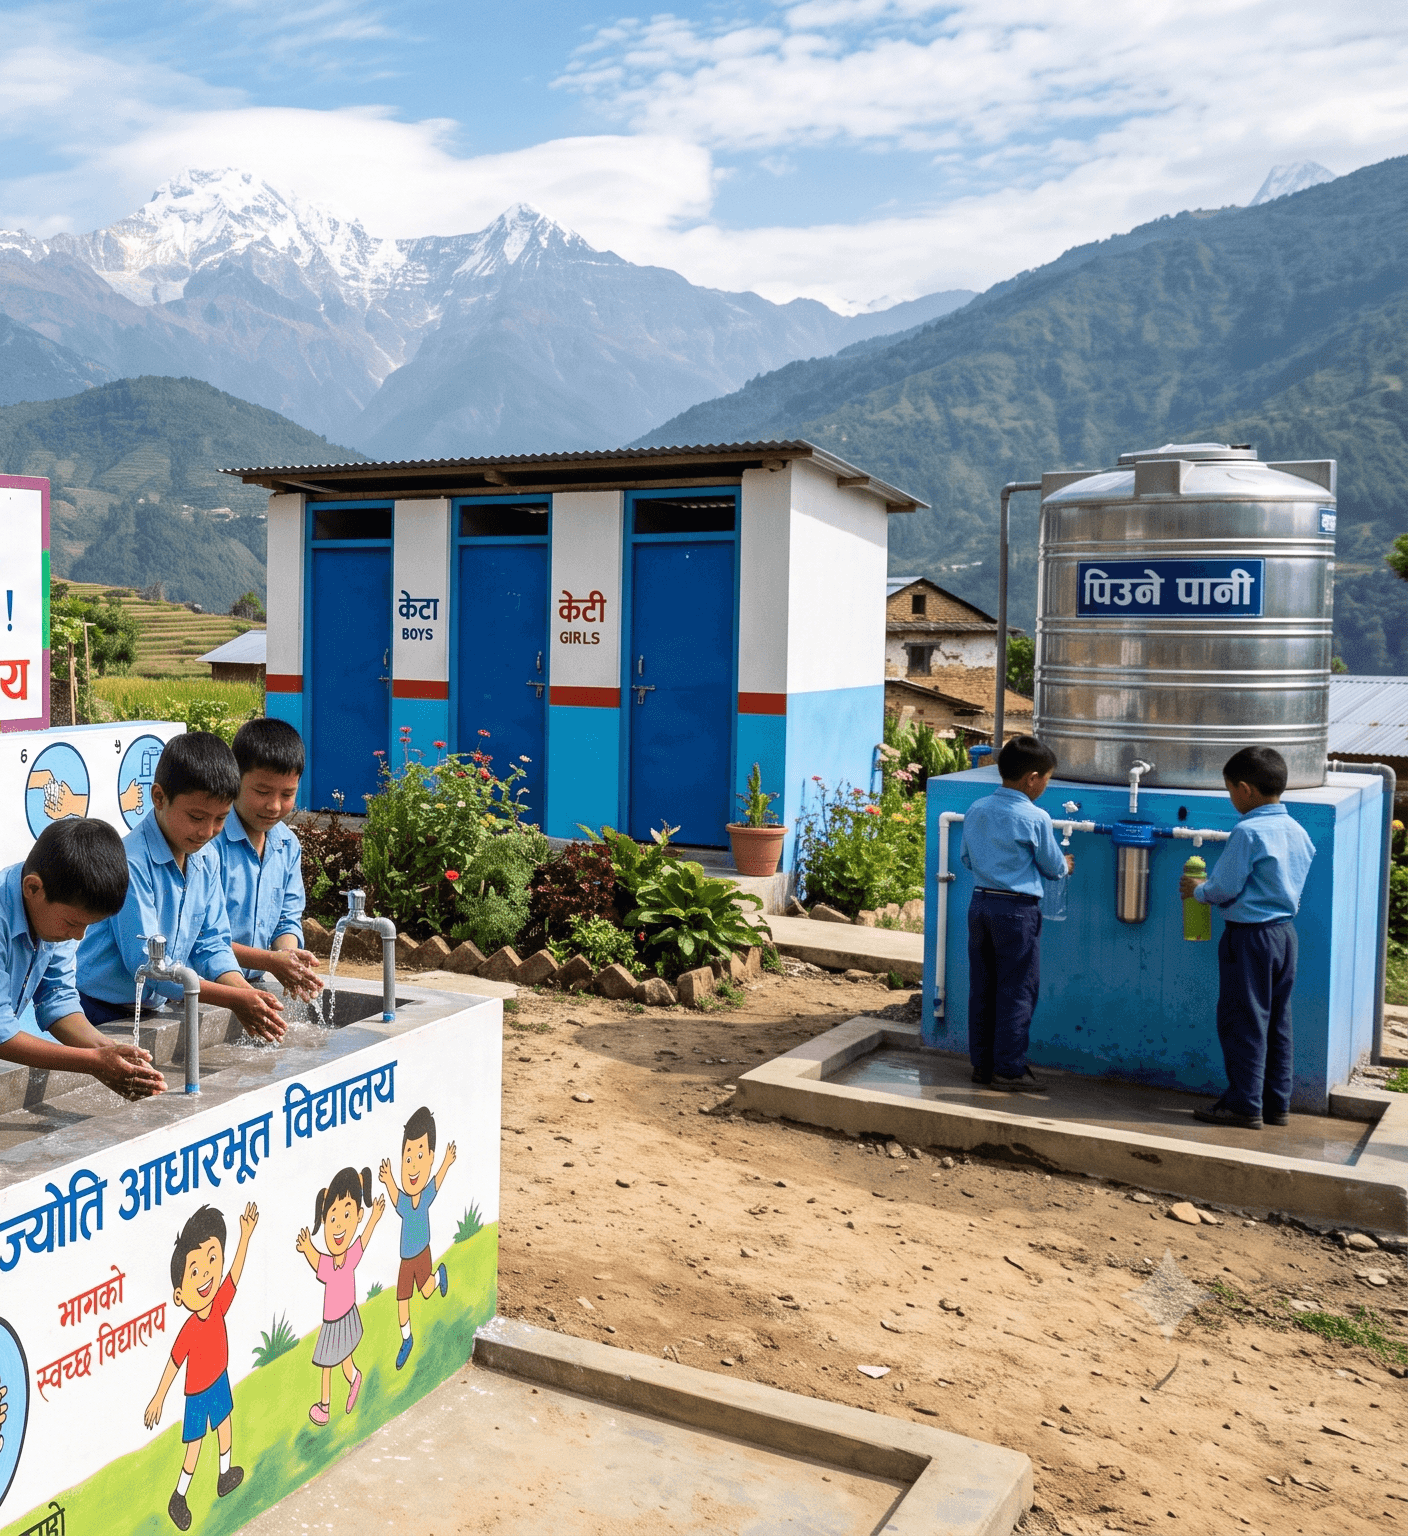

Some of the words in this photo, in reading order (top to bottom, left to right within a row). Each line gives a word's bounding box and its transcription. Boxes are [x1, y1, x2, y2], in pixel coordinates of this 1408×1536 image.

[1084, 569, 1164, 605] पिउने
[1176, 569, 1255, 605] पानी
[398, 590, 439, 620] केटा
[558, 590, 606, 622] केटी
[401, 628, 433, 641] BOYS
[559, 631, 600, 645] GIRLS
[118, 1110, 273, 1221] आधारभूत
[283, 1060, 398, 1148] विद्यालय
[37, 1342, 92, 1402] स्वच्छ
[97, 1302, 167, 1365] विद्यालय
